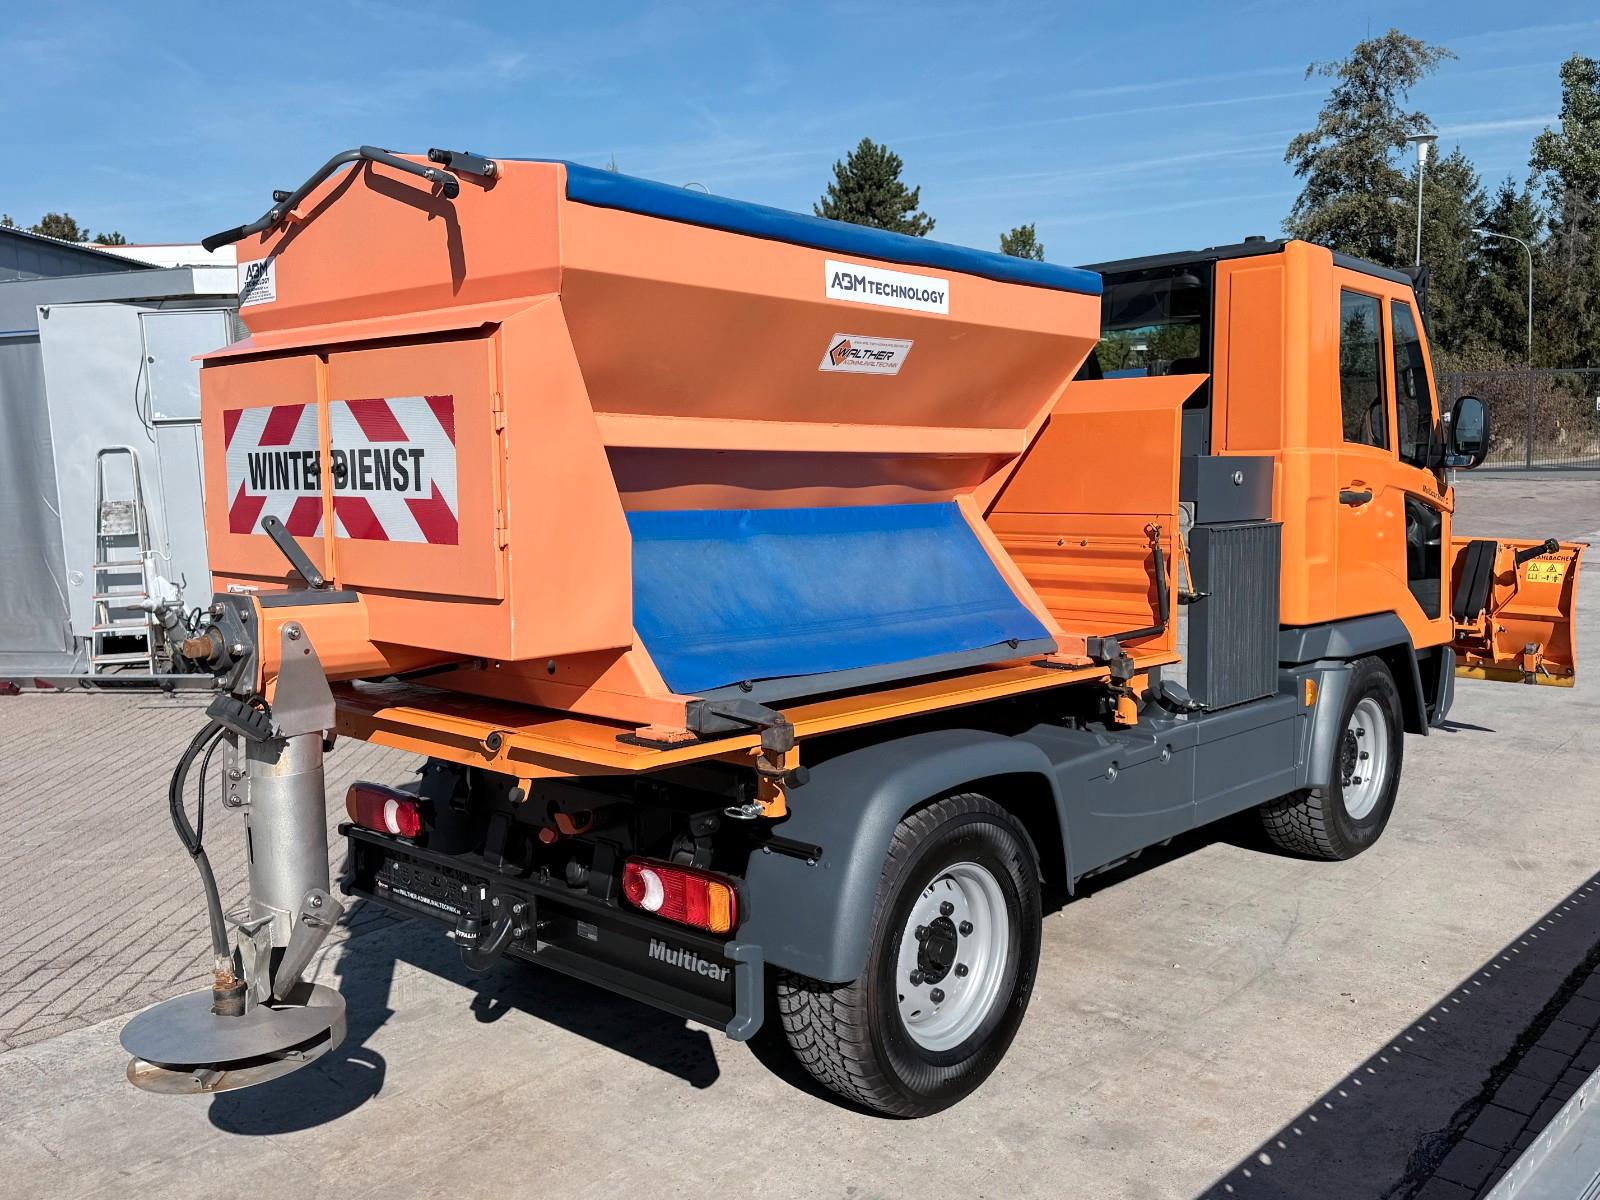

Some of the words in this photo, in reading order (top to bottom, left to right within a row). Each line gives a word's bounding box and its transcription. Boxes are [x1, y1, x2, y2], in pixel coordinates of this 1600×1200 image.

[831, 271, 867, 293] ABM
[867, 280, 945, 304] TECHNOLOGY
[838, 347, 895, 360] WALTHER
[648, 937, 731, 982] Multicar
